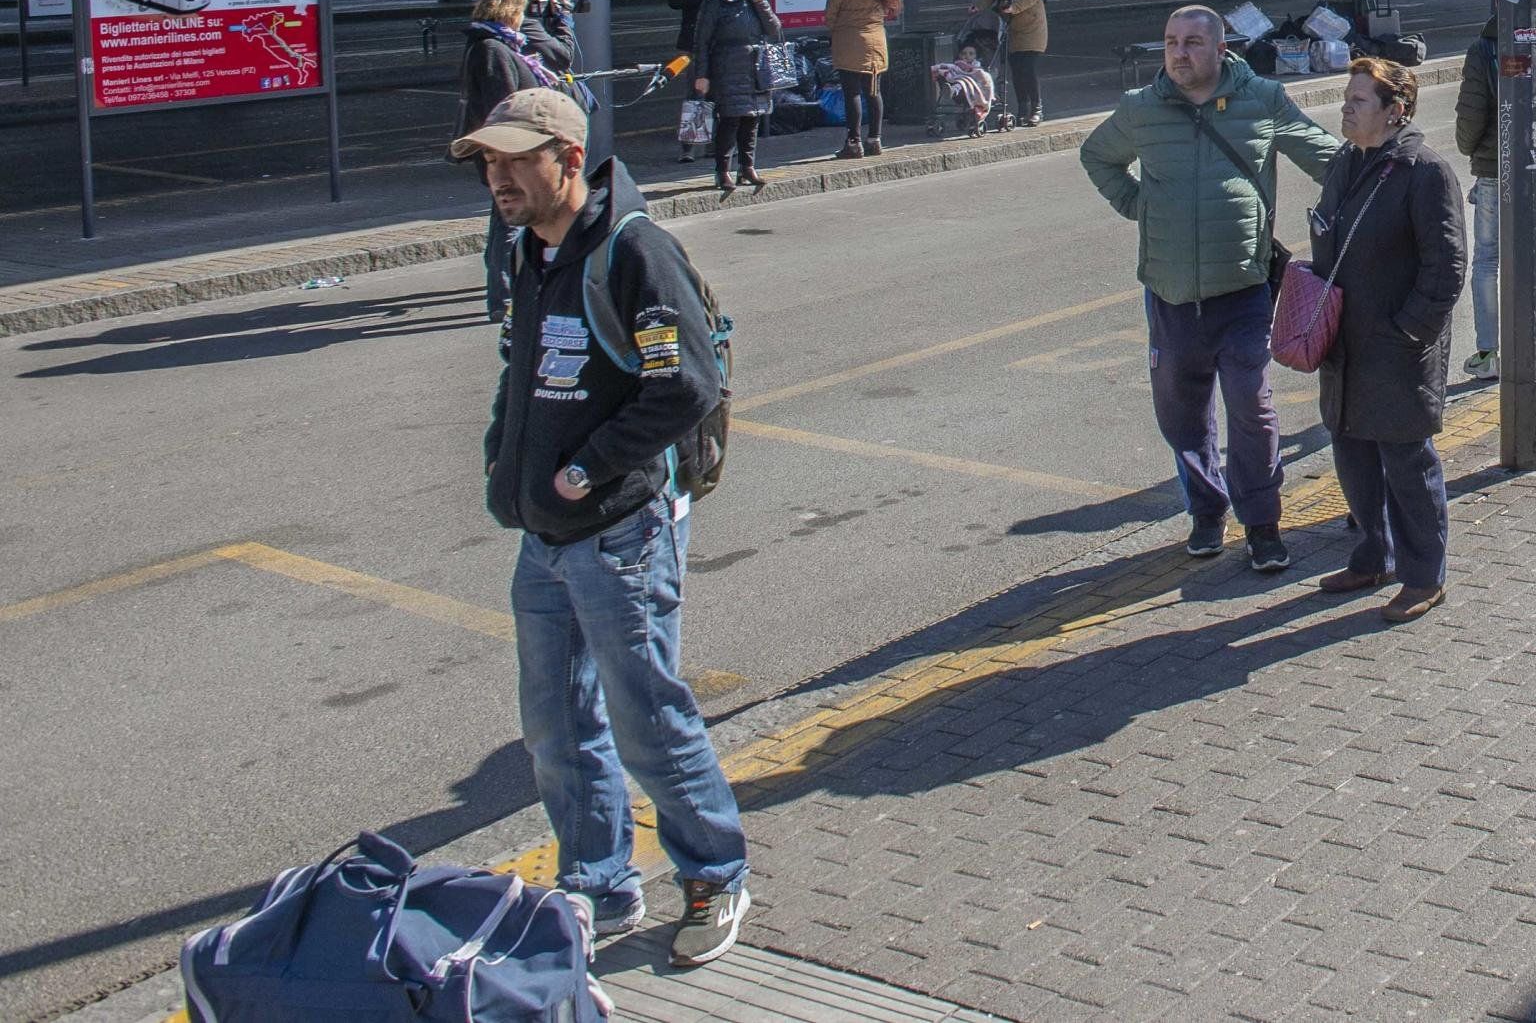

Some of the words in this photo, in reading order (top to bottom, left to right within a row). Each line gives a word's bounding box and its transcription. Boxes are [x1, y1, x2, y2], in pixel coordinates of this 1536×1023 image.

[100, 20, 161, 36] Biglietteria
[163, 16, 205, 31] ONLINE
[207, 17, 224, 28] su:
[100, 31, 222, 49] www.manierilines.com
[101, 53, 133, 64] Rivendite
[102, 64, 121, 74] presso
[184, 56, 205, 66] Milano
[102, 77, 130, 87] Manieri
[131, 75, 153, 85] Lines
[154, 74, 164, 83] srl
[216, 67, 241, 77] Venosa
[534, 388, 574, 400] DUCATI
